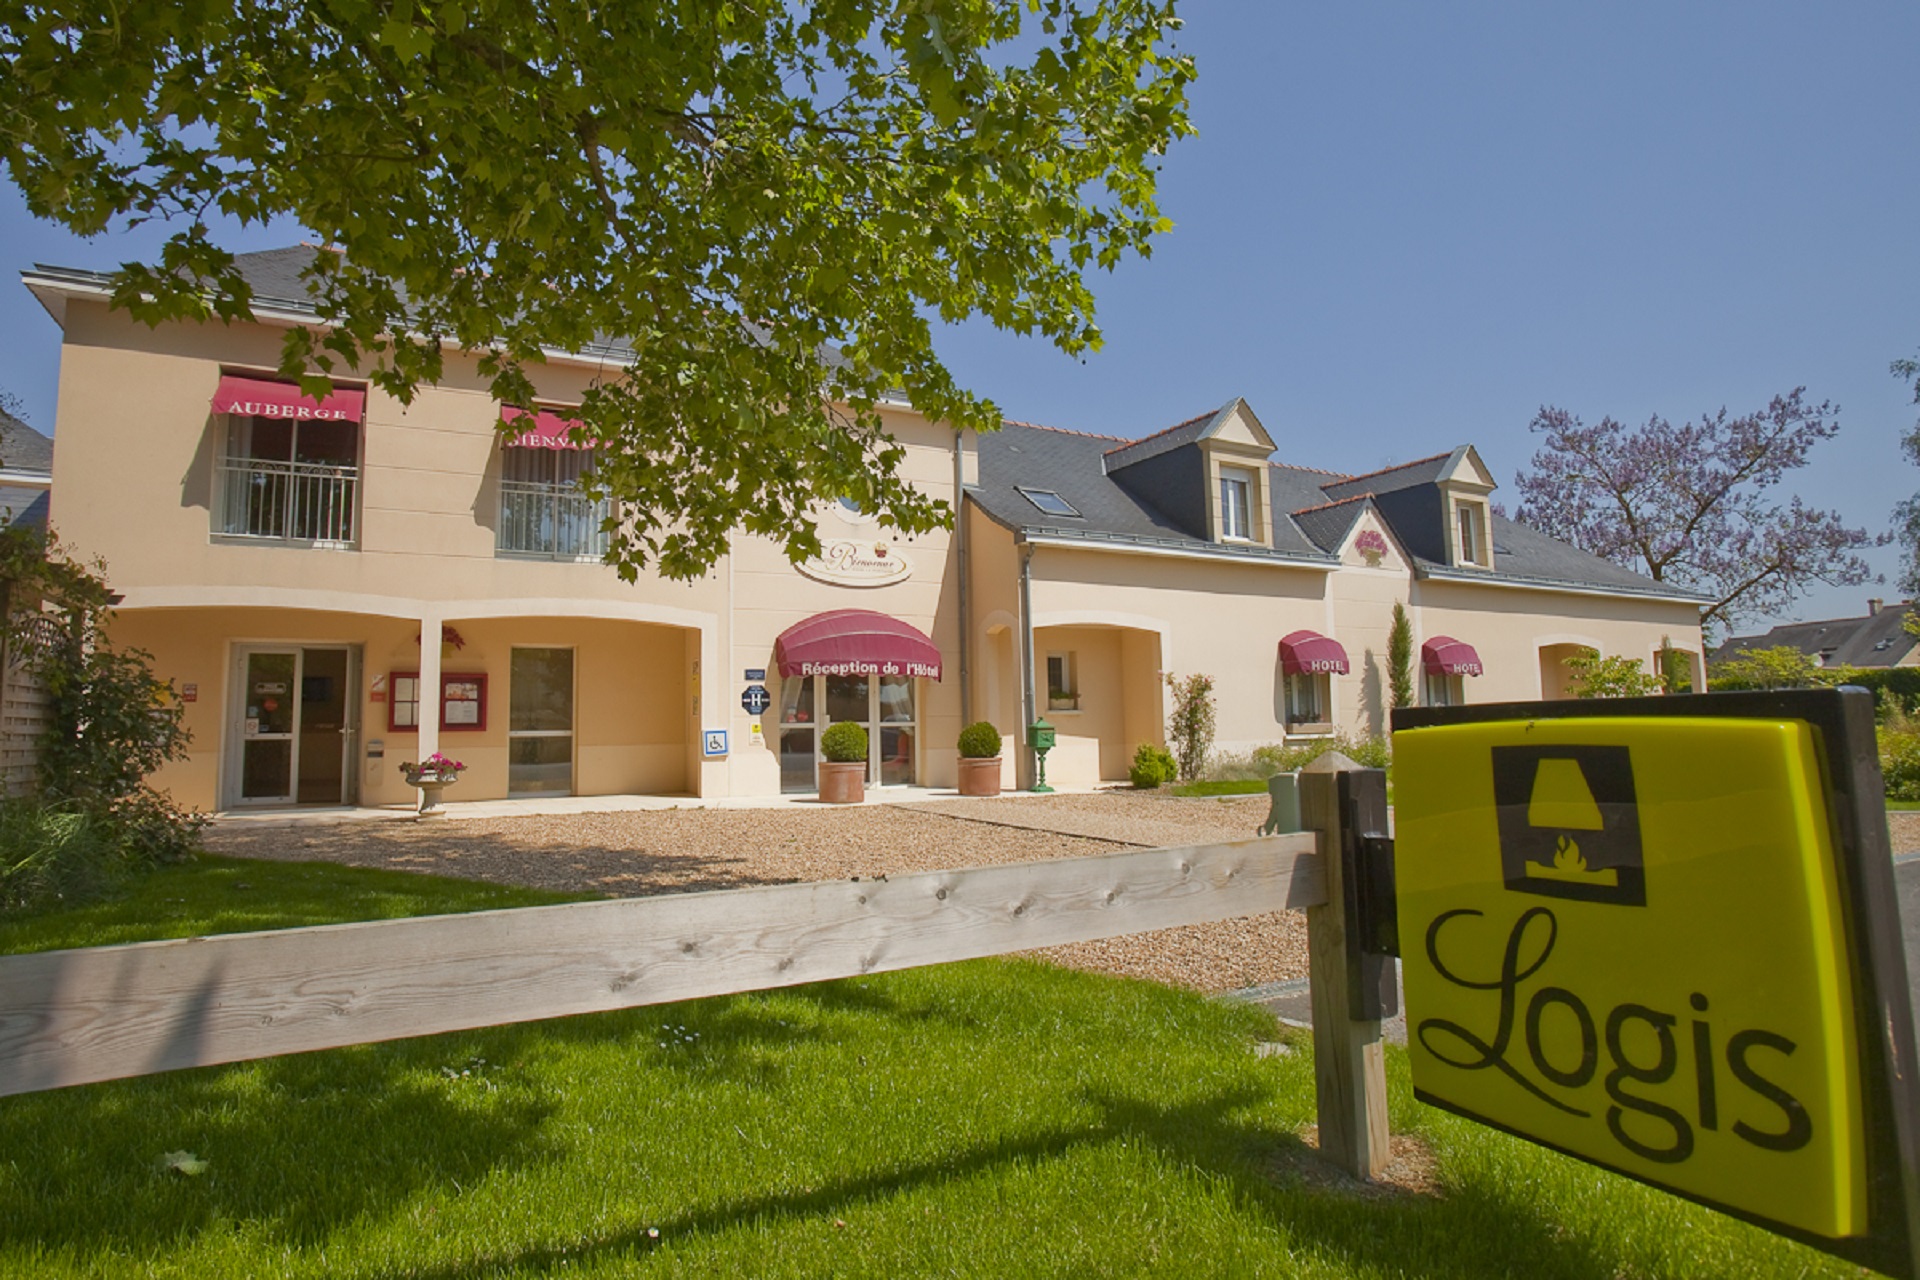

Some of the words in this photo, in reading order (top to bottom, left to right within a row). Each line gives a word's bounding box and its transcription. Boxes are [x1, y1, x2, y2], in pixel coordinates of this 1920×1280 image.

[228, 401, 347, 419] AUBERGE
[802, 661, 878, 675] Réception
[882, 662, 899, 674] de
[751, 693, 761, 706] H
[1417, 906, 1813, 1164] Logis
